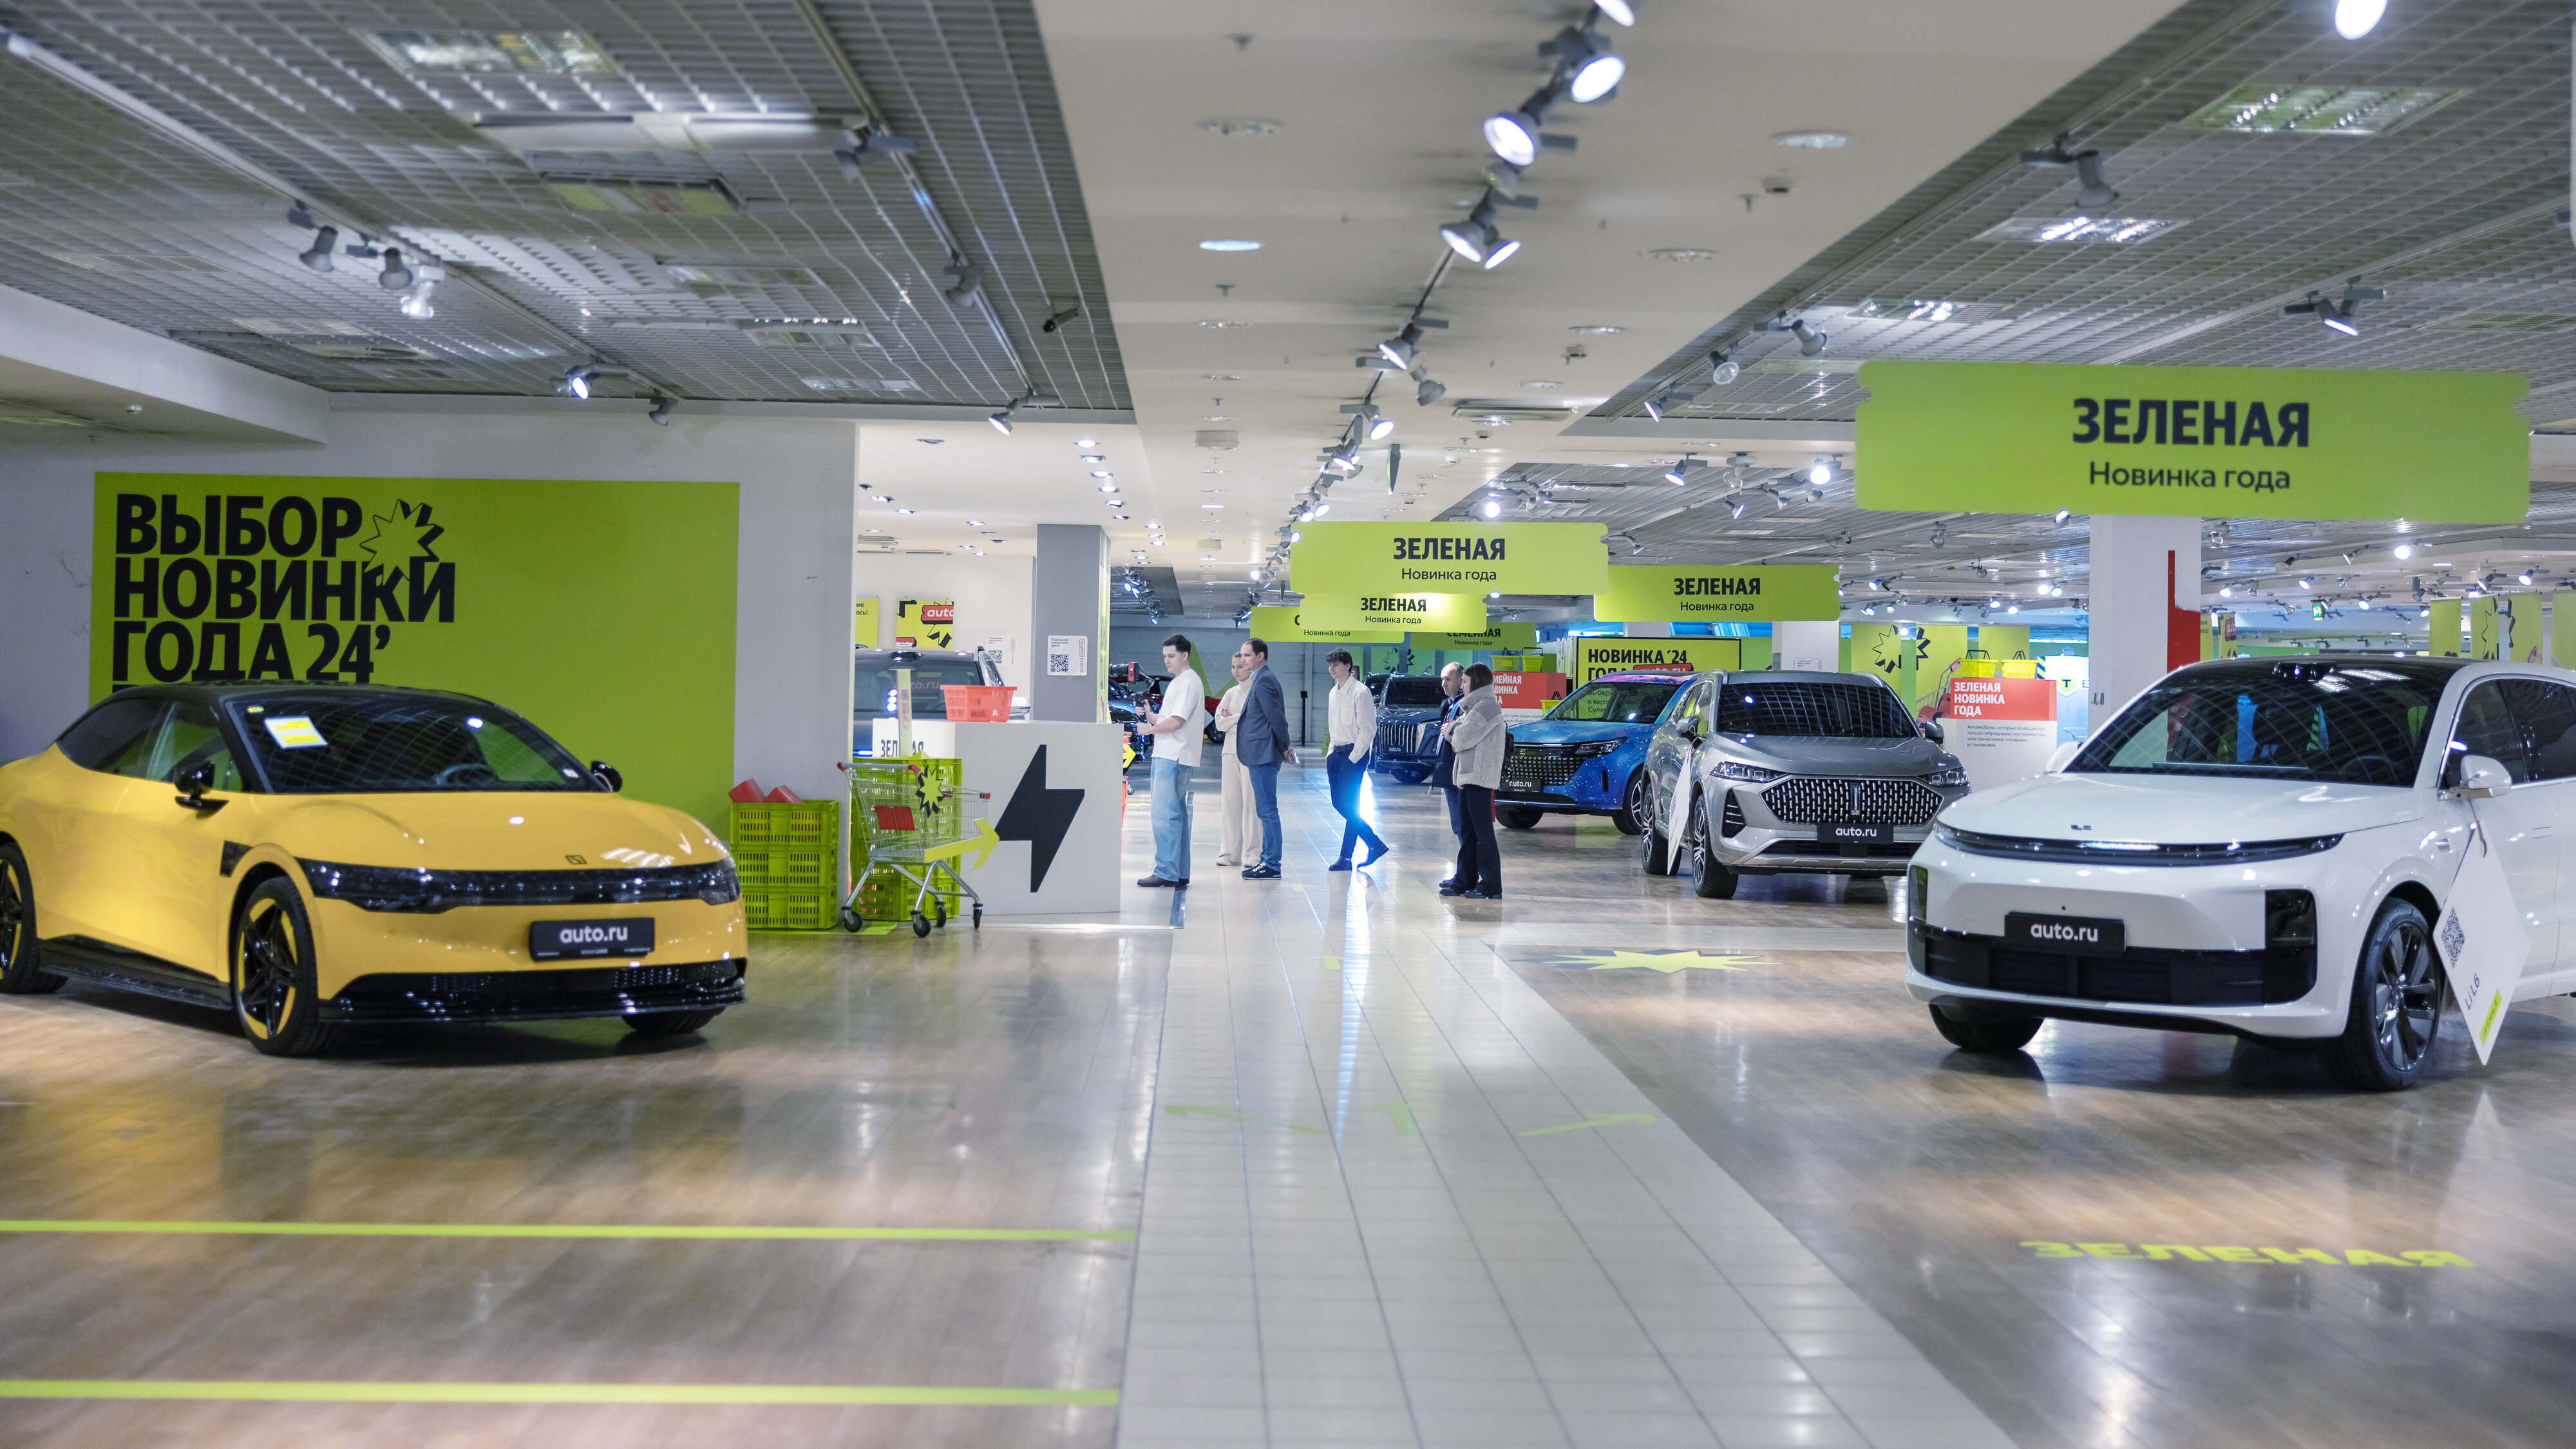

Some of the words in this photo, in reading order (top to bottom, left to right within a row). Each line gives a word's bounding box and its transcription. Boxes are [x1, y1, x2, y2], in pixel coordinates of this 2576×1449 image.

[2072, 397, 2309, 447] ЗЕЛЕНАЯ
[2090, 461, 2216, 488] Новинка
[2224, 469, 2290, 493] года
[115, 493, 363, 558] ВЫБОР
[1393, 537, 1506, 560] ЗЕЛЕНАЯ
[1401, 568, 1462, 580] Новинка
[1465, 571, 1497, 582] года
[113, 556, 456, 623] НОВИНКИ
[1674, 578, 1761, 596] ЗЕЛЕНАЯ
[1360, 597, 1426, 612] ЗЕЛЕНАЯ
[1680, 601, 1727, 611] Новинка
[1730, 603, 1754, 612] года
[112, 620, 294, 683] ГОДА
[1588, 649, 1664, 663] НОВИНКА
[1493, 673, 1522, 685] МЕЙНАЯ
[1588, 667, 1627, 681] ГО
[1493, 685, 1519, 695] ВИНКА
[1954, 681, 2001, 692] ЗЕЛЕНАЯ
[1954, 693, 2005, 705] НОВИНКА
[1954, 705, 1982, 717] ГОДА
[880, 739, 924, 757] ЗЕЛАЯ
[1835, 827, 1877, 837] auto.ru
[560, 925, 629, 943] auto.ru
[2031, 923, 2098, 942] auto.ru
[2020, 1241, 2478, 1267] ЗЕЛЕНАЯ
